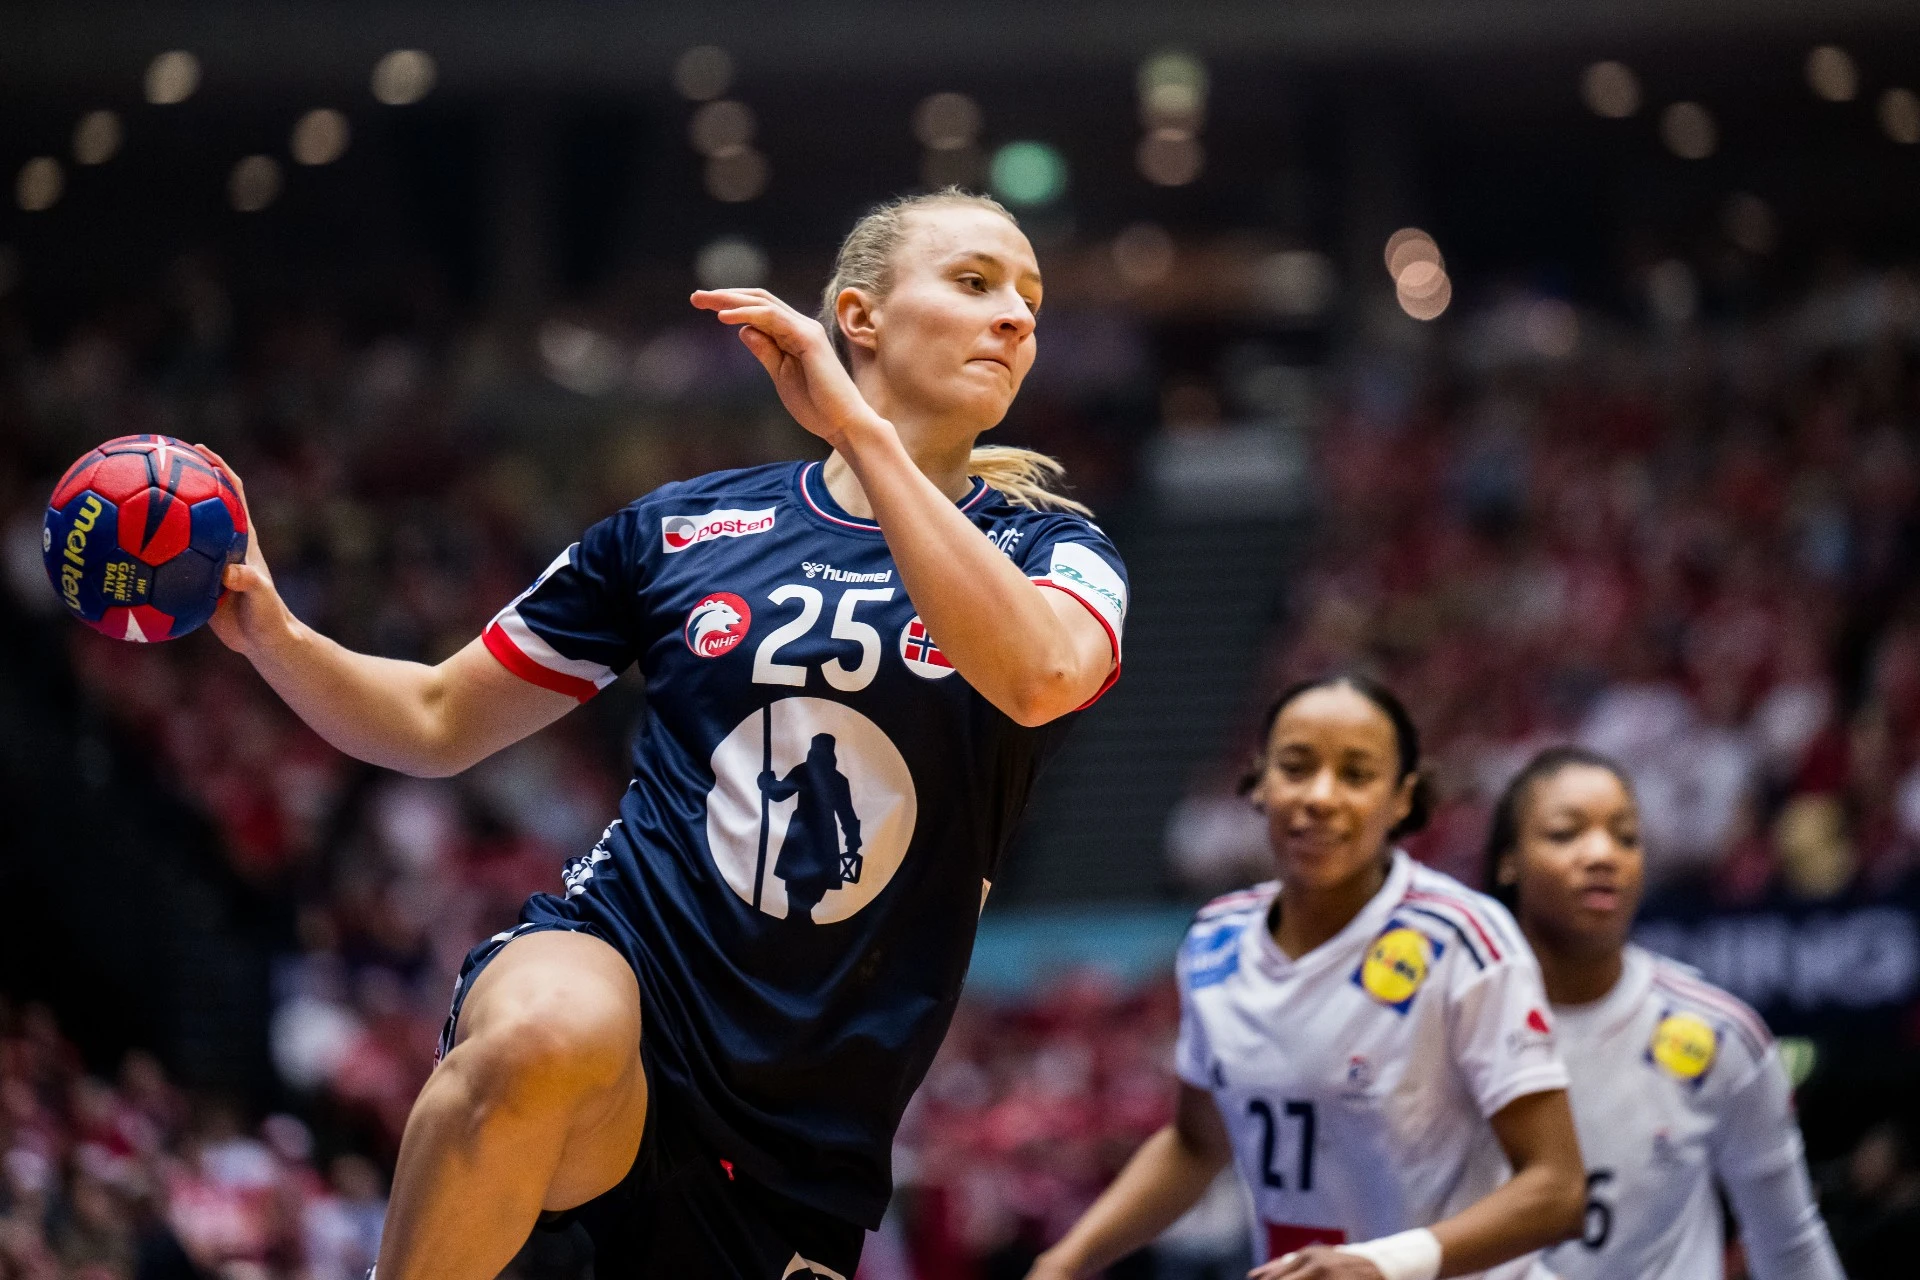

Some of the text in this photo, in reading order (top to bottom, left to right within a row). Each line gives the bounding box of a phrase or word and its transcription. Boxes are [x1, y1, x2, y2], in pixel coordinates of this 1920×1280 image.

[697, 515, 773, 541] posten
[61, 496, 103, 613] molten
[103, 562, 118, 593] BALL
[114, 562, 130, 601] GAME
[822, 564, 892, 583] hummel
[707, 634, 740, 651] NHF
[751, 583, 896, 692] 25
[1246, 1098, 1315, 1192] 27
